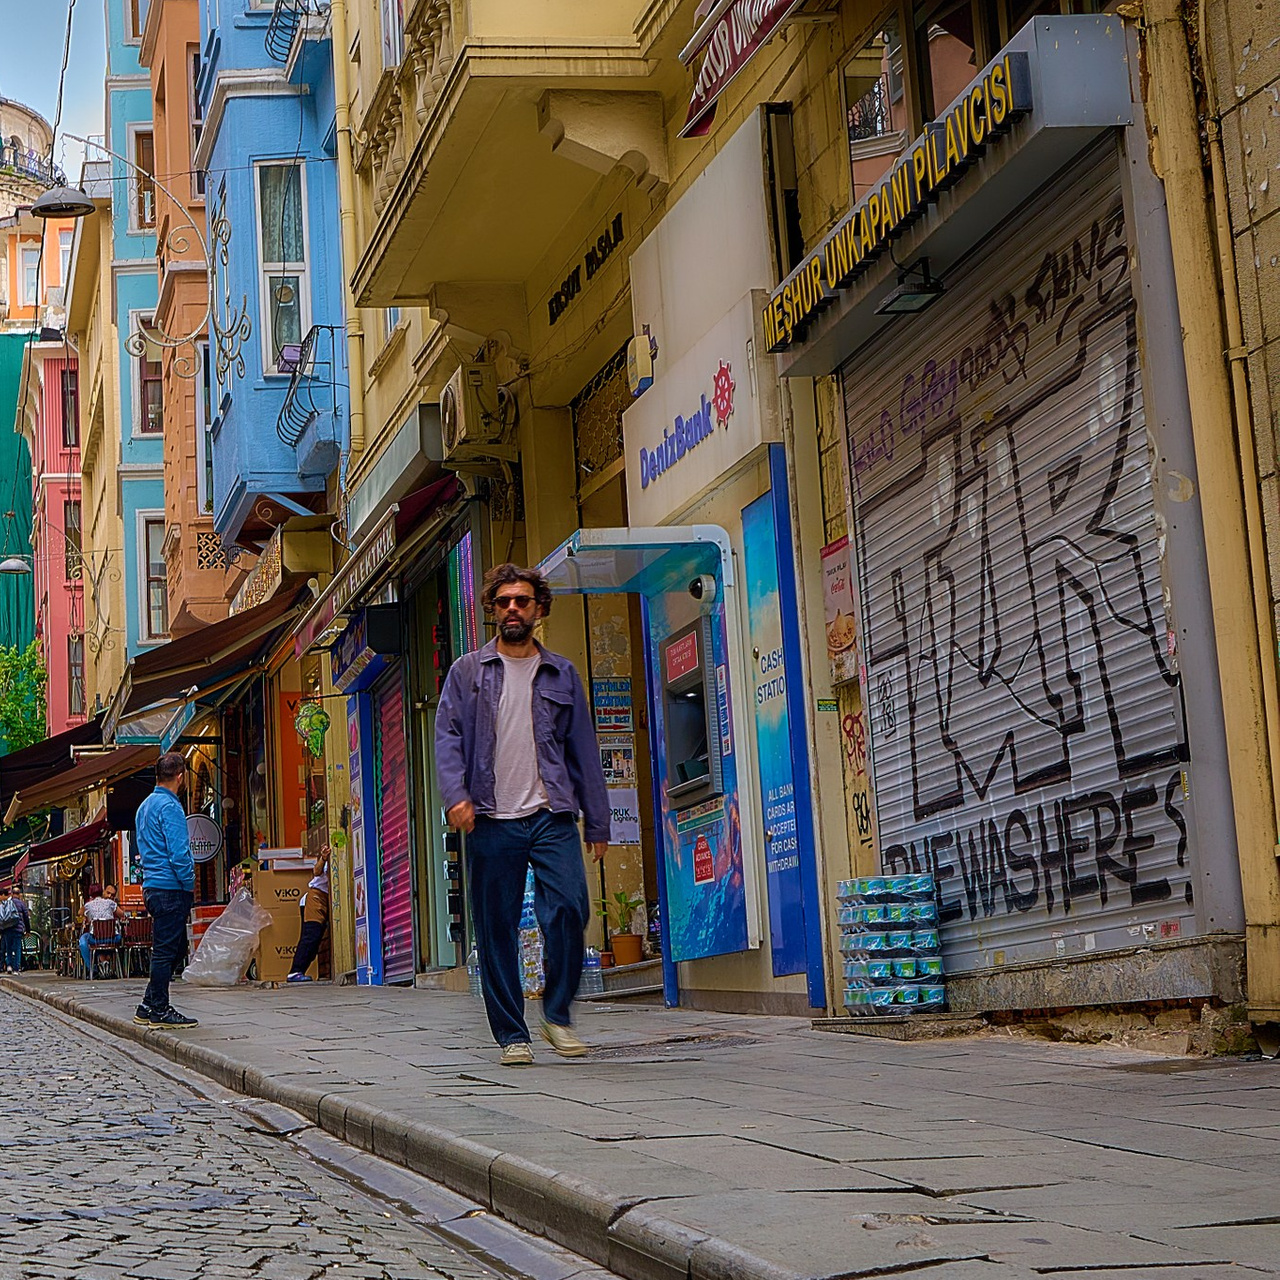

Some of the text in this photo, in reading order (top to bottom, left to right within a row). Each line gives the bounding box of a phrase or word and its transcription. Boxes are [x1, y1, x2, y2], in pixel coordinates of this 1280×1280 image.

[762, 54, 1015, 354] MEŞHUR UNKAPANI PİLAVCISI
[639, 393, 715, 490] DenizBank
[760, 647, 784, 674] CASH
[757, 675, 785, 704] STATIO
[768, 788, 779, 802] ALL
[766, 800, 795, 820] CARDS AR
[771, 841, 783, 855] FOR
